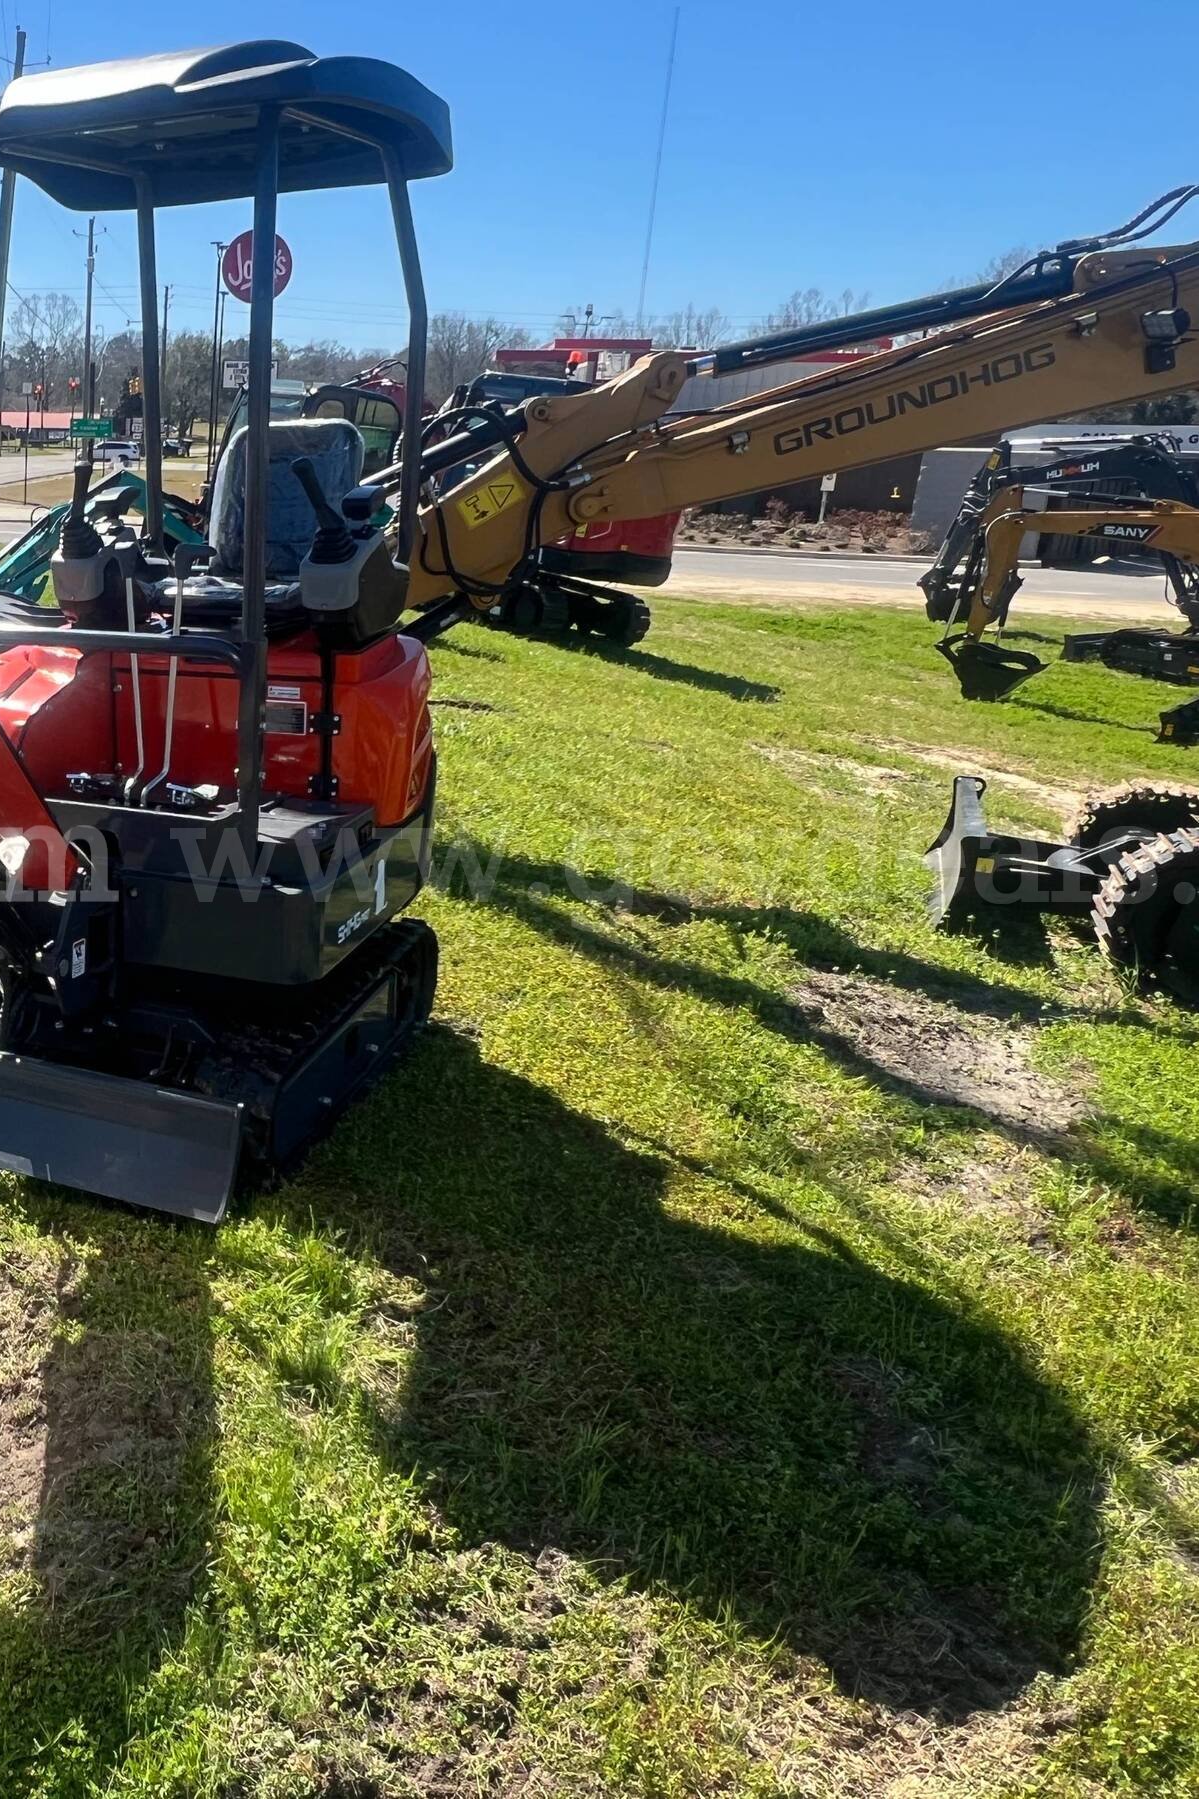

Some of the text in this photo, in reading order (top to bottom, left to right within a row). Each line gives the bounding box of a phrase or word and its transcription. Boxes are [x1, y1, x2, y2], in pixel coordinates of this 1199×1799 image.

[228, 243, 286, 287] Ja's
[773, 343, 1056, 456] GROUNDHOG
[1103, 525, 1149, 538] SANY
